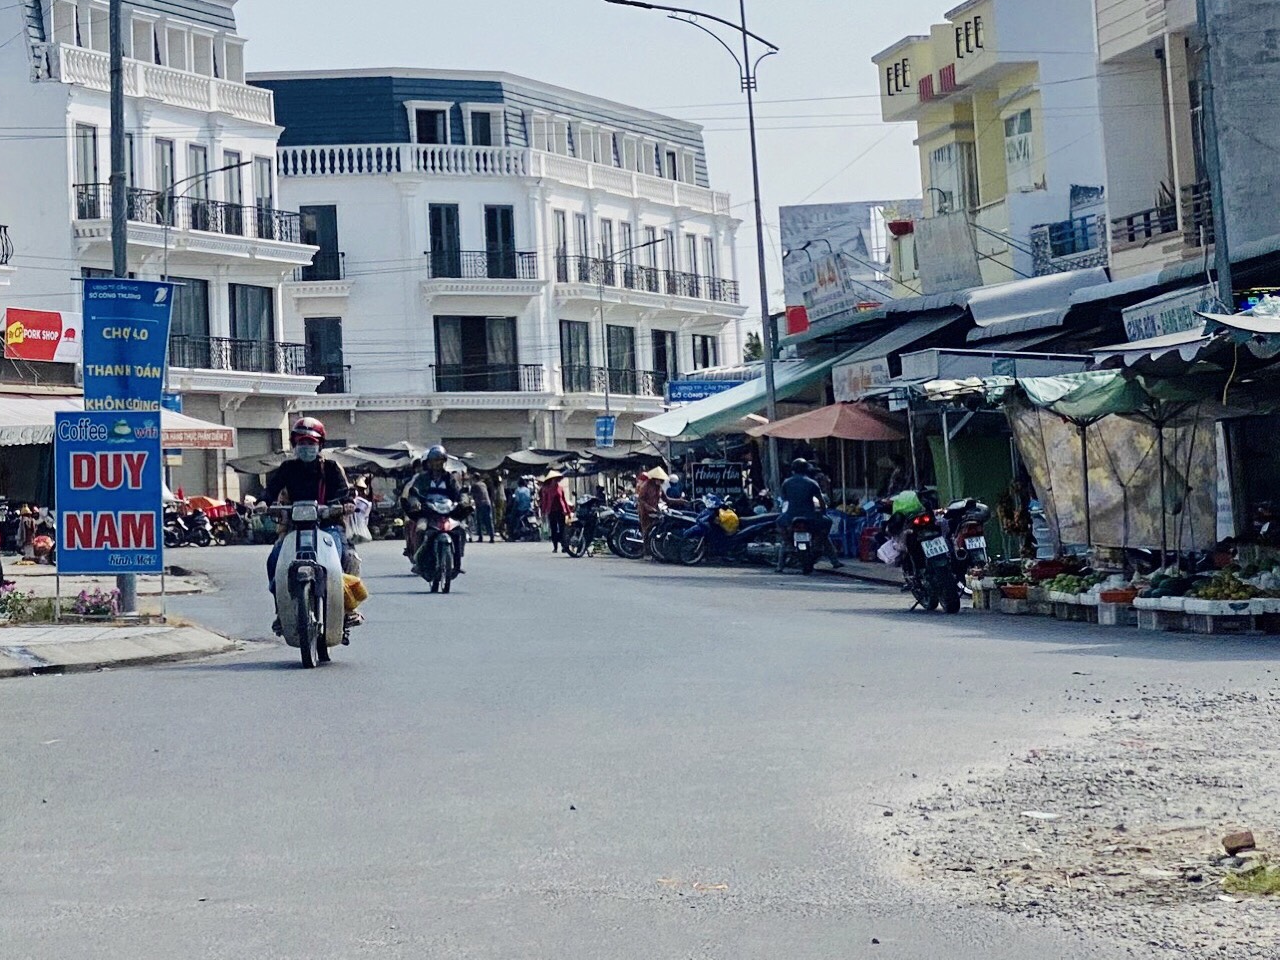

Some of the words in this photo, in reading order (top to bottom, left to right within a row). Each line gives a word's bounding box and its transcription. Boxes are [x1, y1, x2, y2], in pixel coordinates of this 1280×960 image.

[24, 329, 41, 339] PORK
[42, 331, 59, 341] SHOP
[102, 326, 131, 342] CHỢ
[58, 418, 108, 442] Coffee
[70, 451, 148, 490] DUY
[63, 511, 156, 550] NAM
